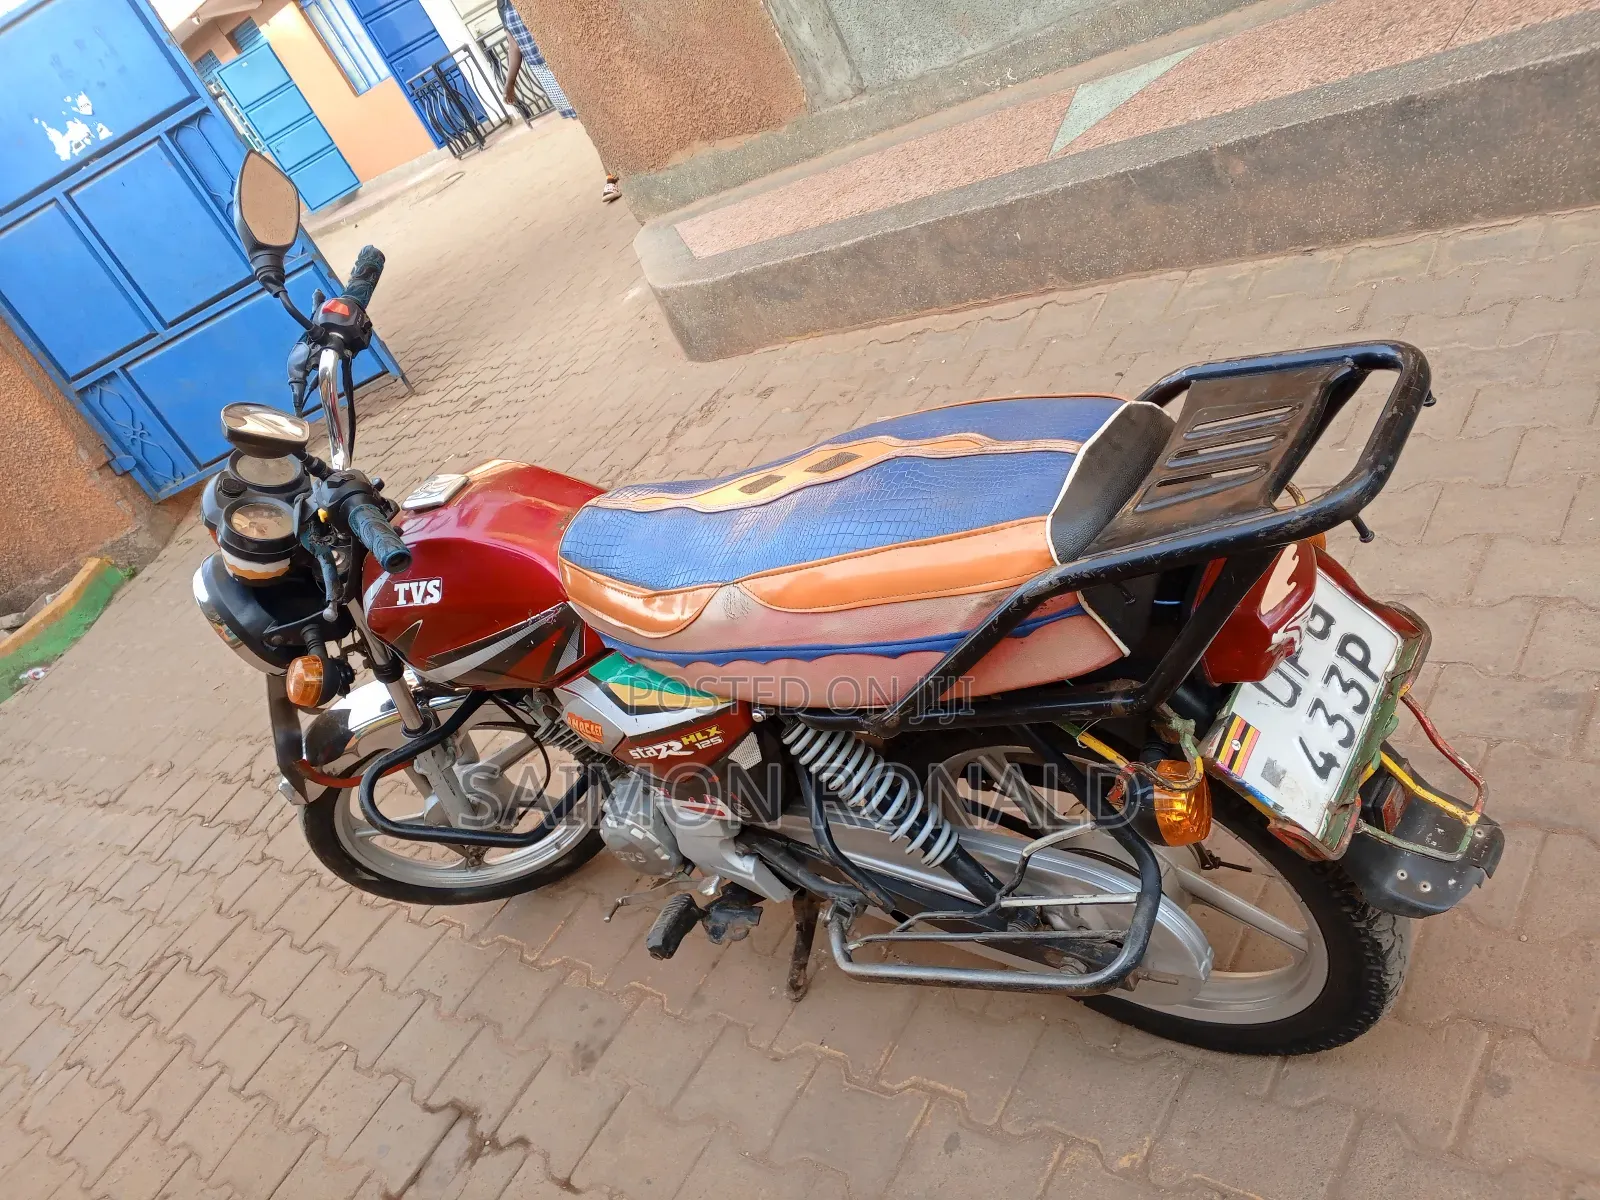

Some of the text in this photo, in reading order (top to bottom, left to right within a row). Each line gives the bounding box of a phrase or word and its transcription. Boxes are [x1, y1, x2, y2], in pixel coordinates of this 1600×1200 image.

[393, 579, 441, 606] TVS
[1298, 632, 1380, 781] 433P
[681, 726, 723, 746] HLX
[695, 735, 723, 750] 125
